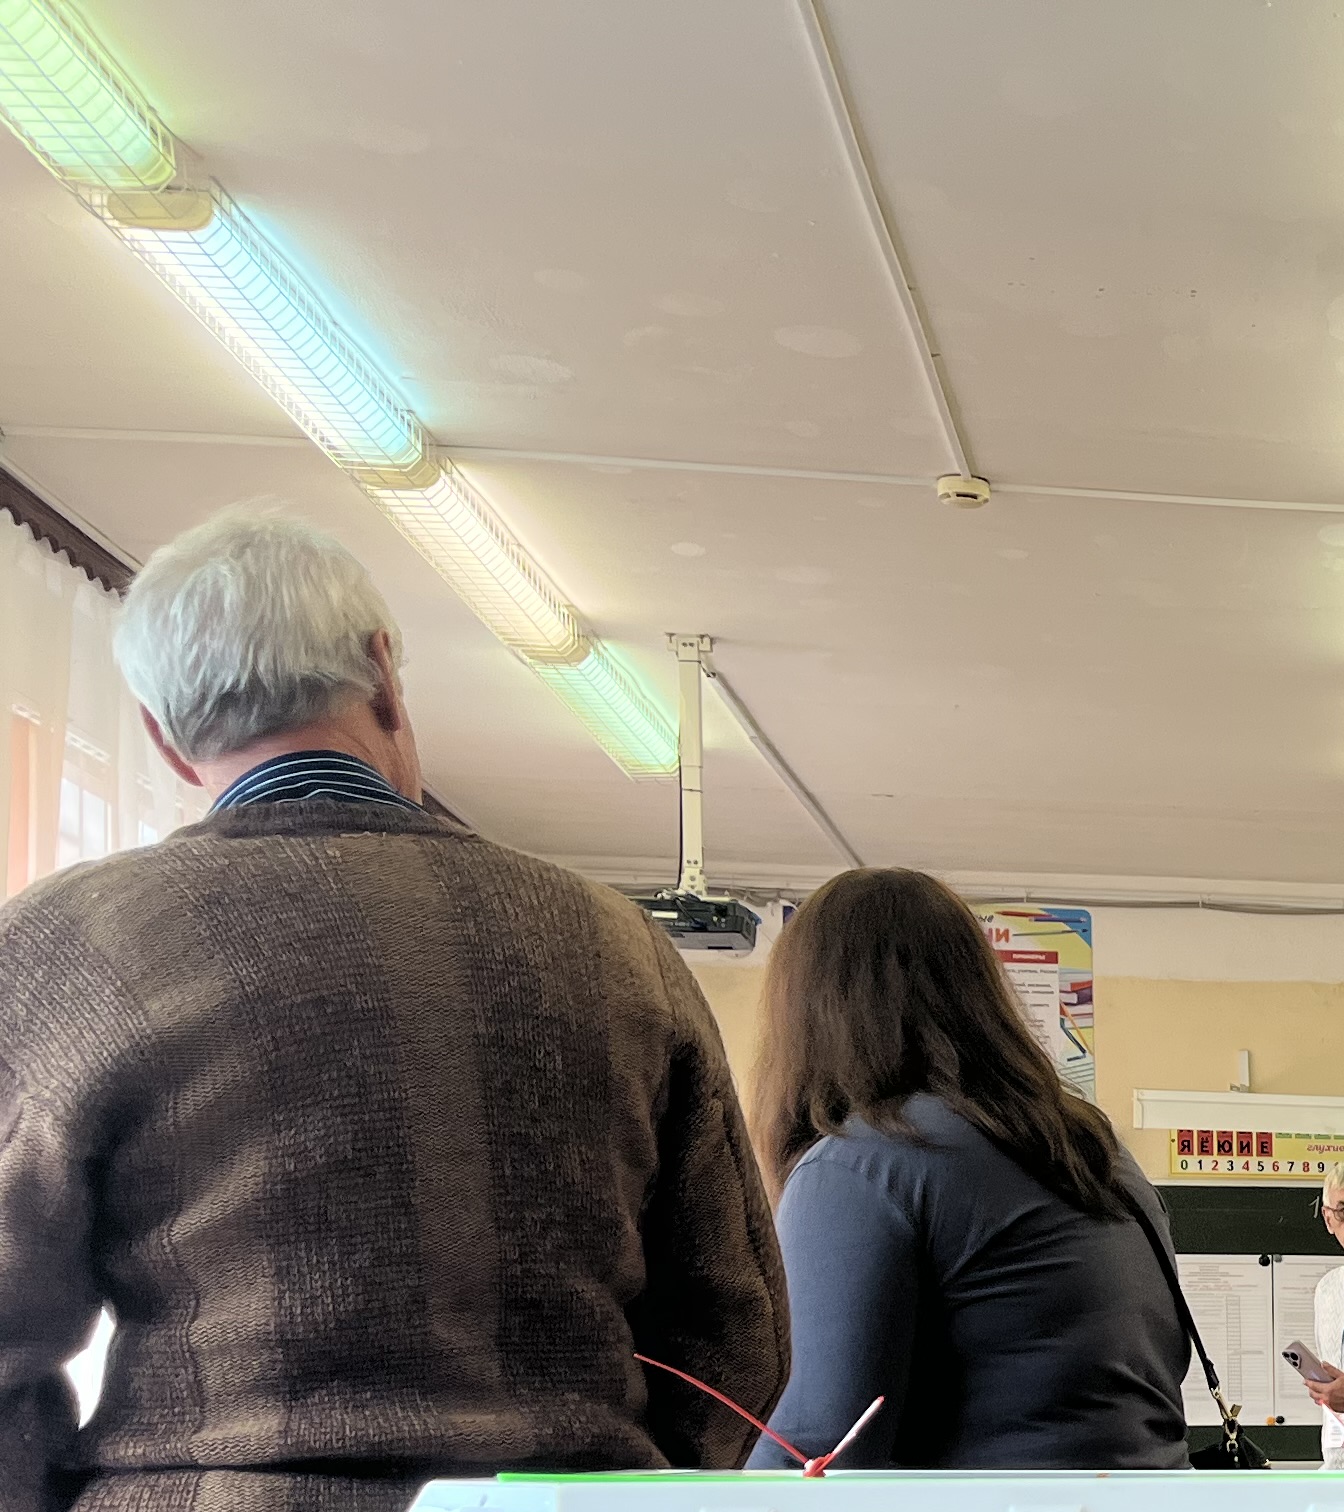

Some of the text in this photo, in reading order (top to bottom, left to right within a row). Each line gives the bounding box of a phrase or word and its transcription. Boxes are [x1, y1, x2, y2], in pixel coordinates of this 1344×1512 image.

[1180, 1137, 1269, 1154] Я Ё Ю И Е
[1307, 1143, 1344, 1154] глухие
[1180, 1159, 1188, 1170] 0
[1197, 1159, 1203, 1170] 1
[1211, 1160, 1219, 1171] 2
[1227, 1160, 1234, 1171] 3
[1242, 1160, 1250, 1171] 4
[1257, 1161, 1264, 1172] 5
[1272, 1161, 1280, 1172] 6
[1287, 1161, 1295, 1172] 7
[1302, 1161, 1310, 1172] 8
[1317, 1162, 1325, 1173] 9
